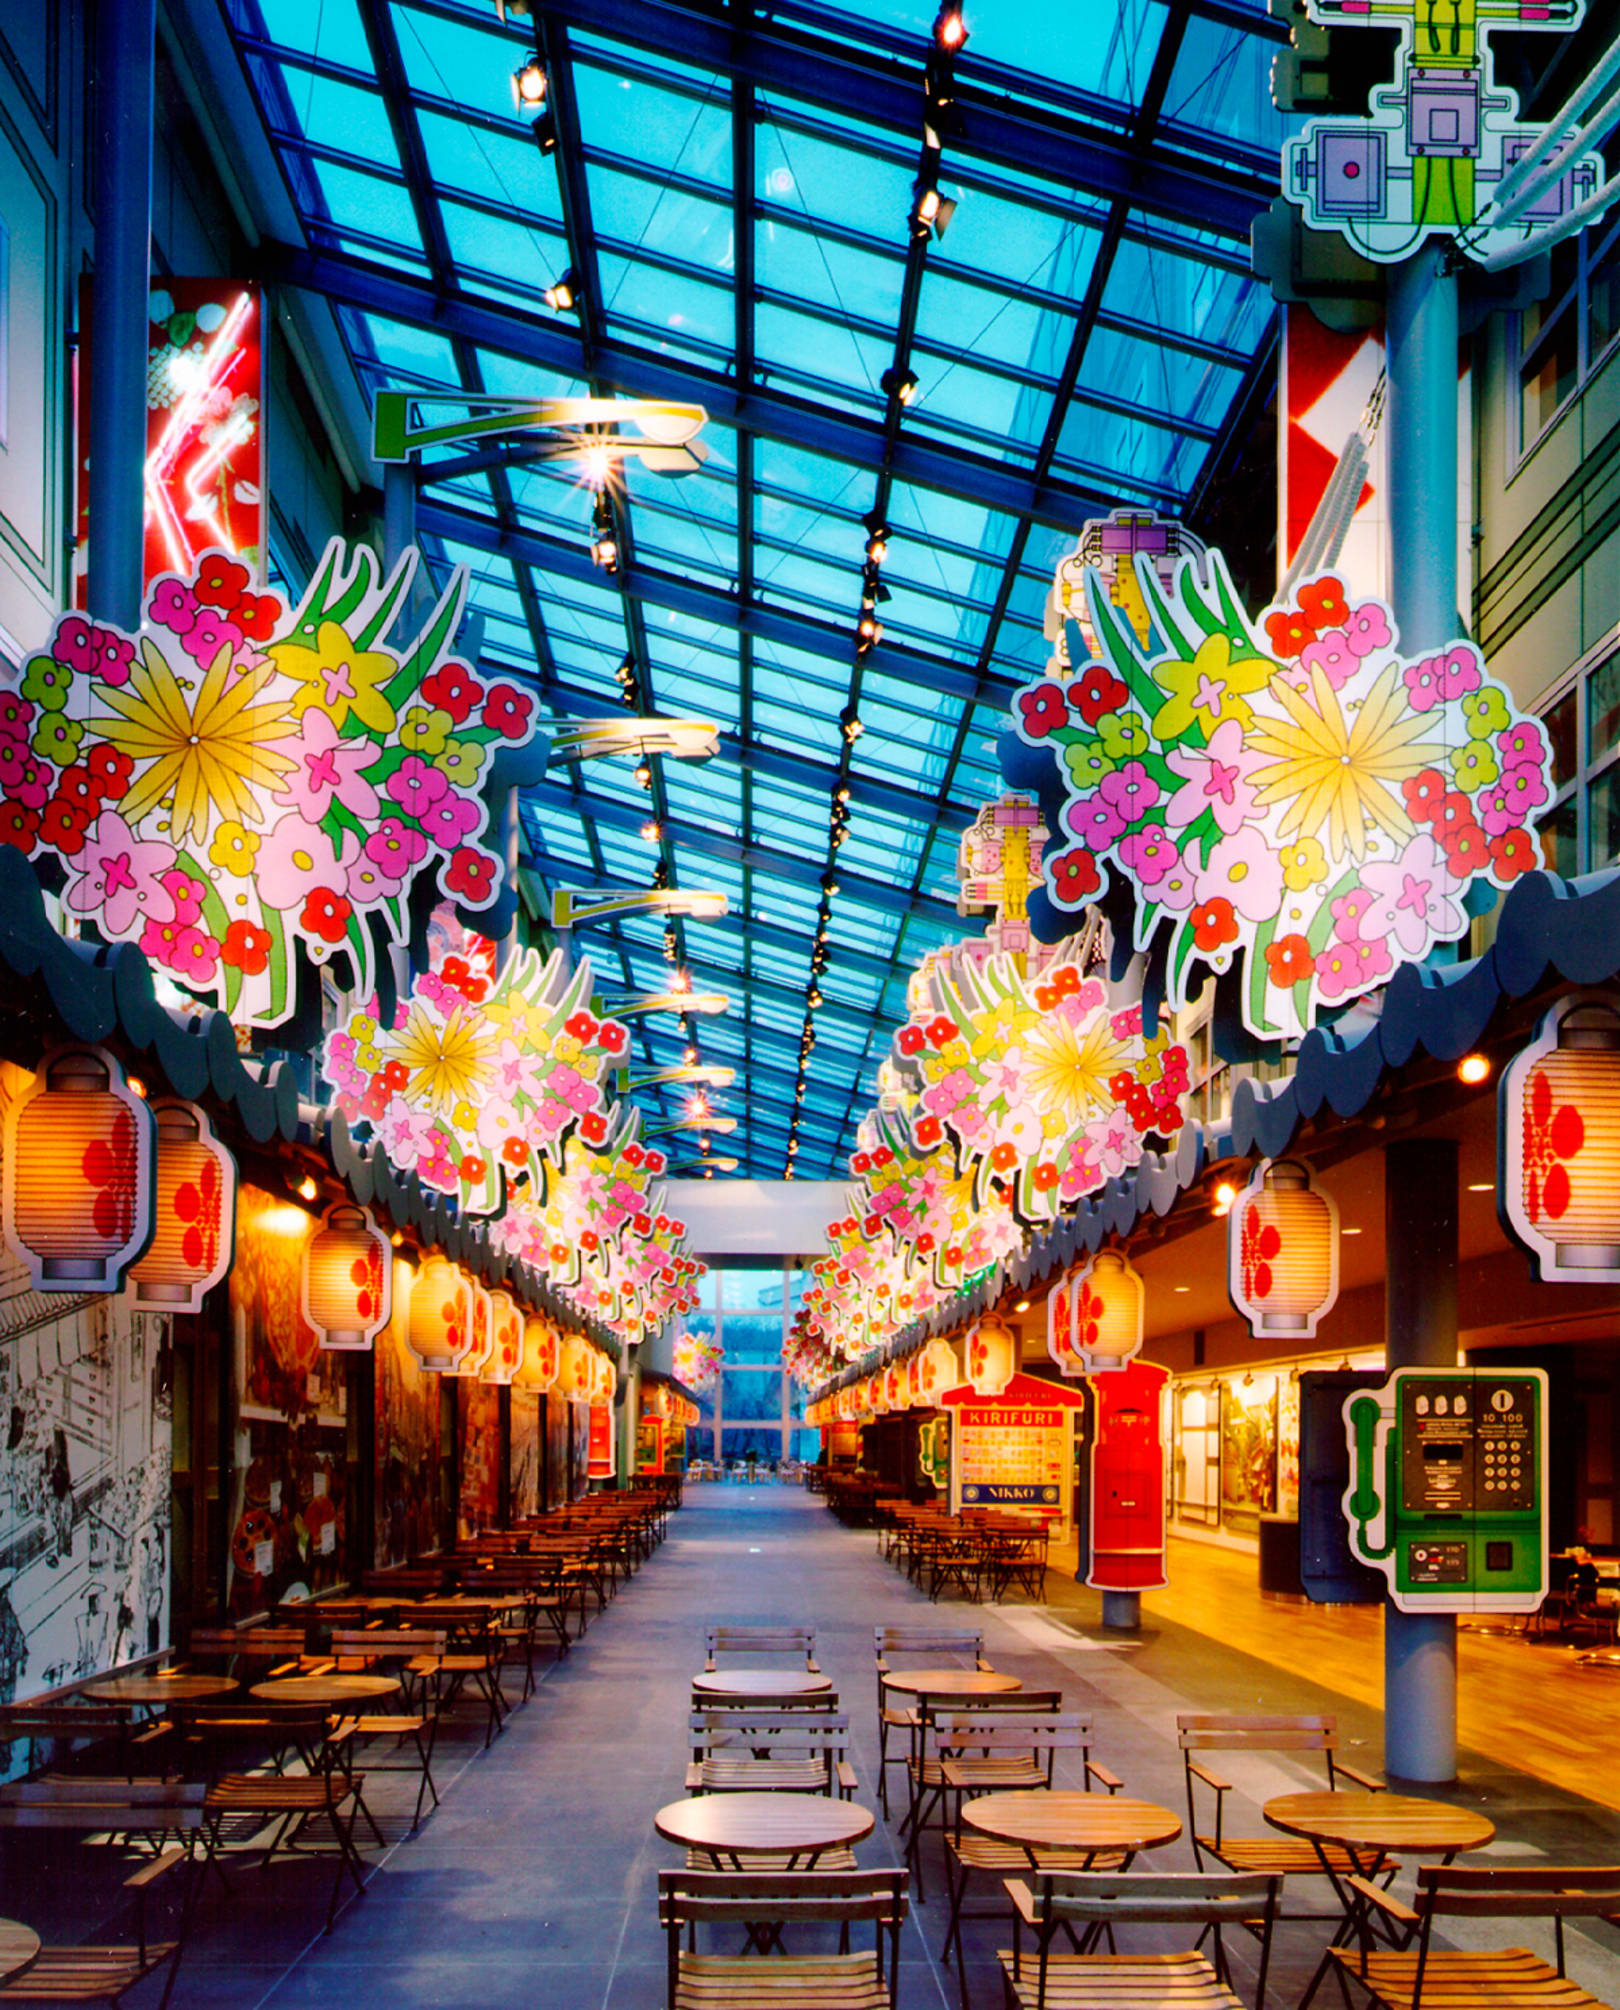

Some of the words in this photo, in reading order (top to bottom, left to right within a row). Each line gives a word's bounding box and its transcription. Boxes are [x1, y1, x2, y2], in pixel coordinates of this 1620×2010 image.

[970, 1412, 1053, 1425] KIRIFURI
[1482, 1413, 1496, 1422] 10
[1502, 1413, 1523, 1423] 100
[988, 1487, 1035, 1499] NIKKO
